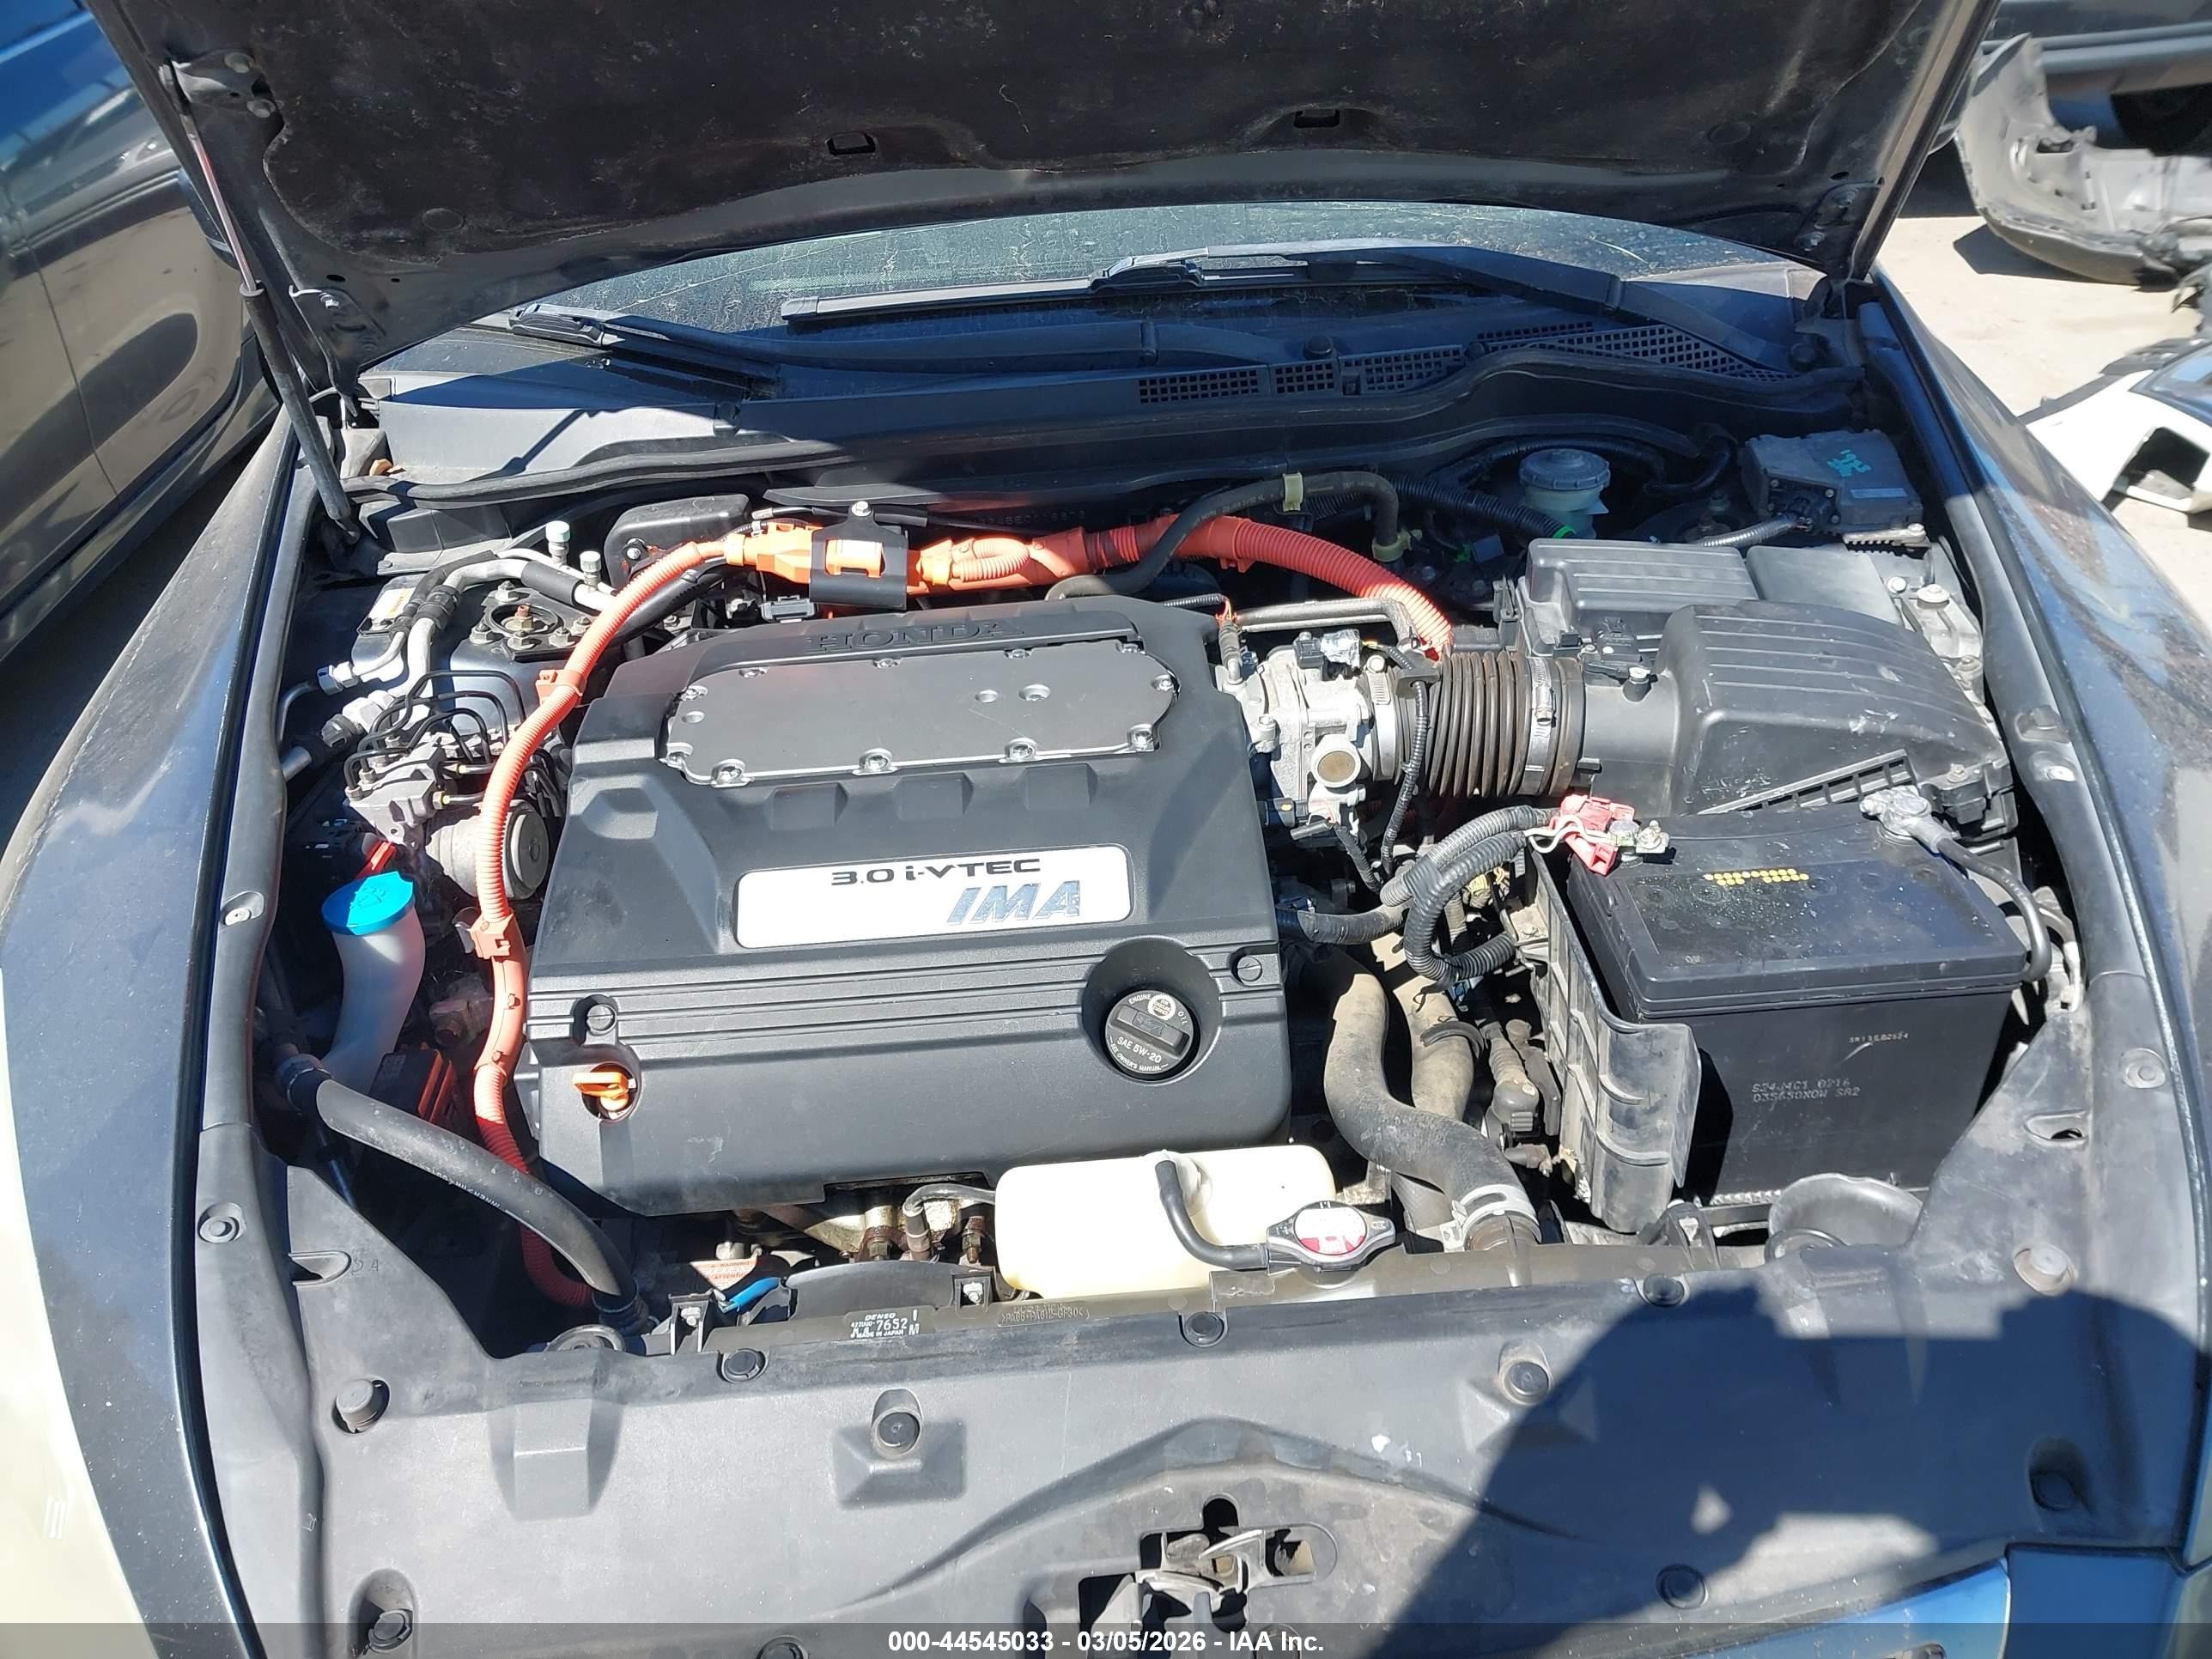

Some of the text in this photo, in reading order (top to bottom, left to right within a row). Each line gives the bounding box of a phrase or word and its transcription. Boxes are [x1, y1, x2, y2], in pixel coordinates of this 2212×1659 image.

[806, 621, 1024, 653] HONDA
[831, 859, 1041, 886] 3.0 i-VTEC
[947, 879, 1082, 926] IMA
[1128, 994, 1151, 1005] ENGINE
[1177, 1011, 1189, 1026] OIL
[1117, 1036, 1133, 1049] SAE
[865, 1312, 896, 1322] DENSO
[883, 1328, 904, 1337] JAPAN
